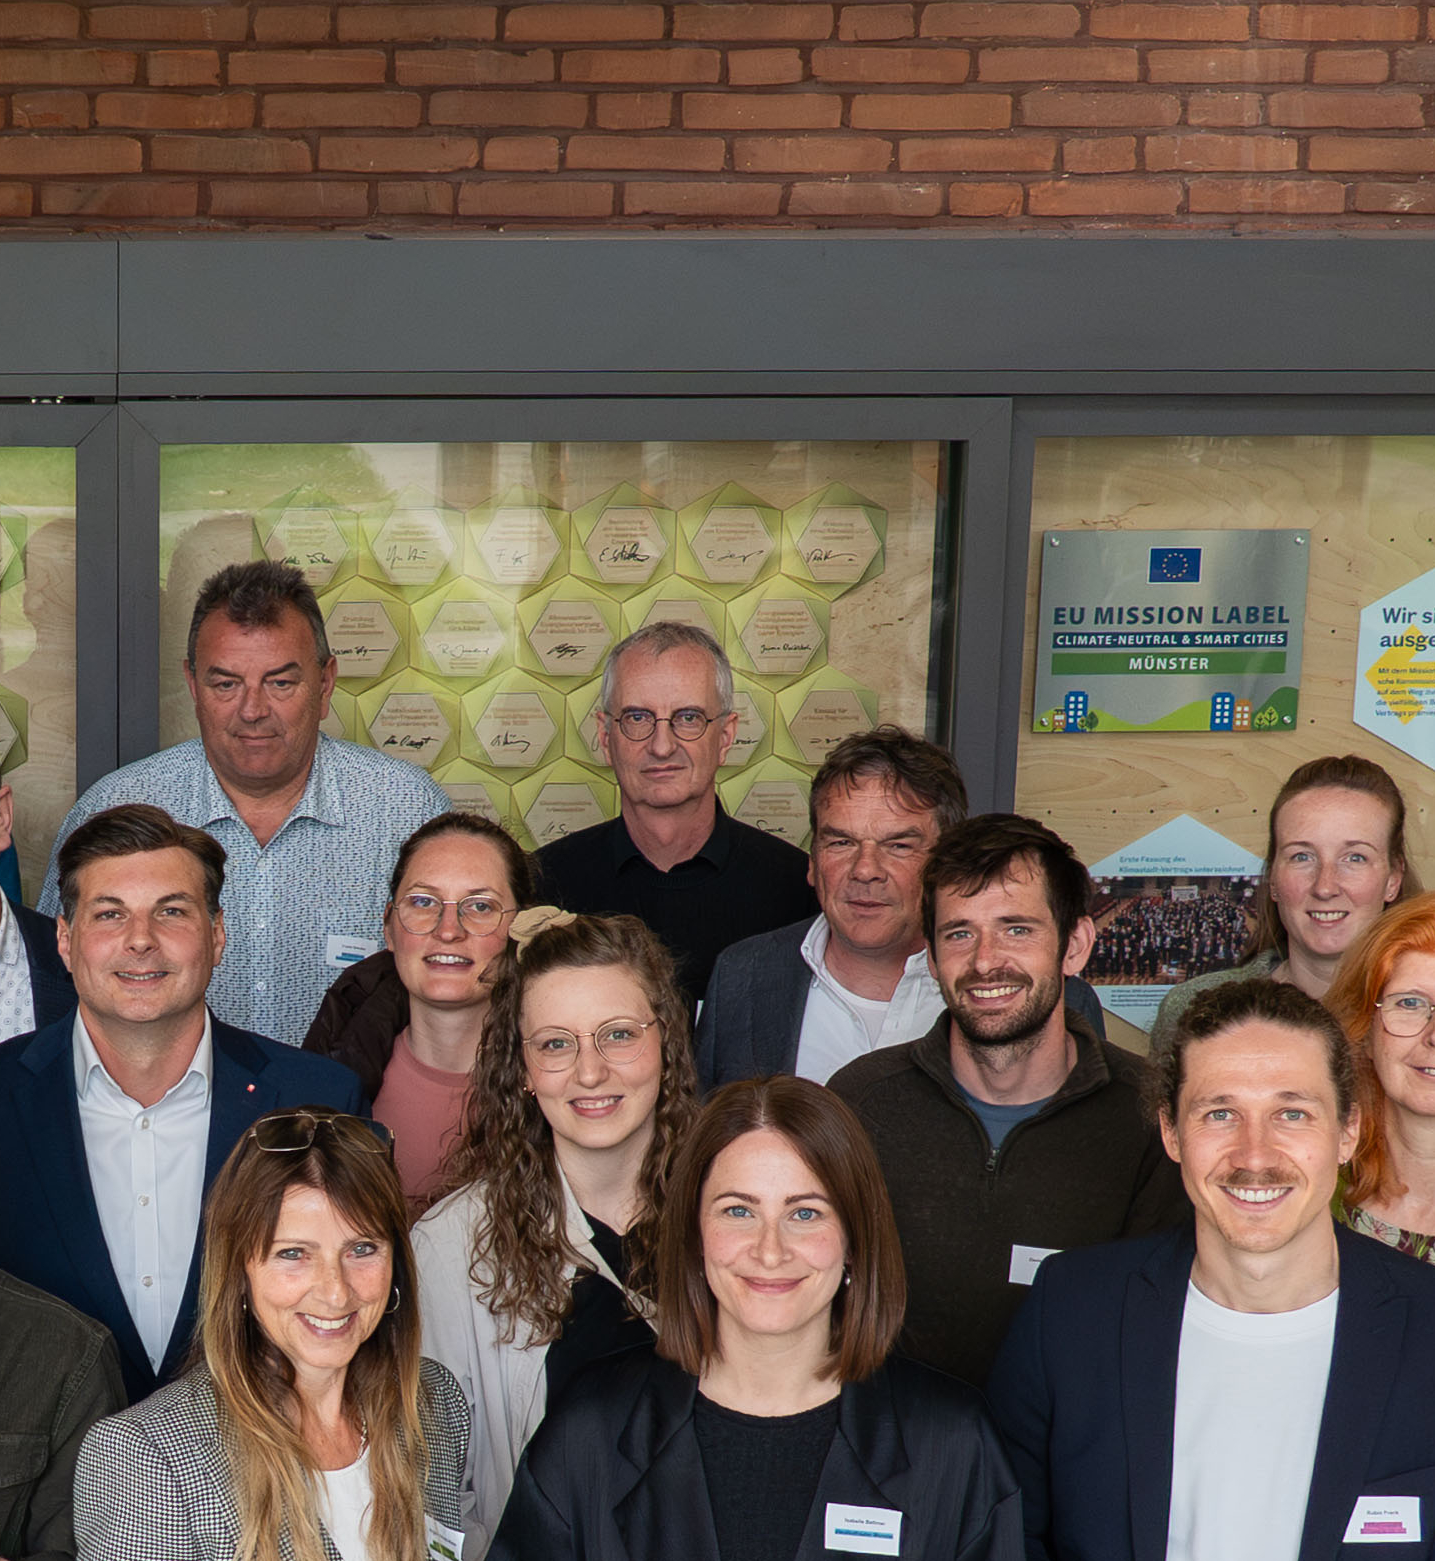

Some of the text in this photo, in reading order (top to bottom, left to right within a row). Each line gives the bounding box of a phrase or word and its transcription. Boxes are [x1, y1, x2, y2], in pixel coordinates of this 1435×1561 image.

[1053, 606, 1290, 624] EU MISSION LABEL
[1383, 607, 1417, 624] Wir
[1056, 633, 1285, 645] CLIMATE-NEUTRAL & SMART CITIES
[1129, 656, 1209, 670] MÜNSTER
